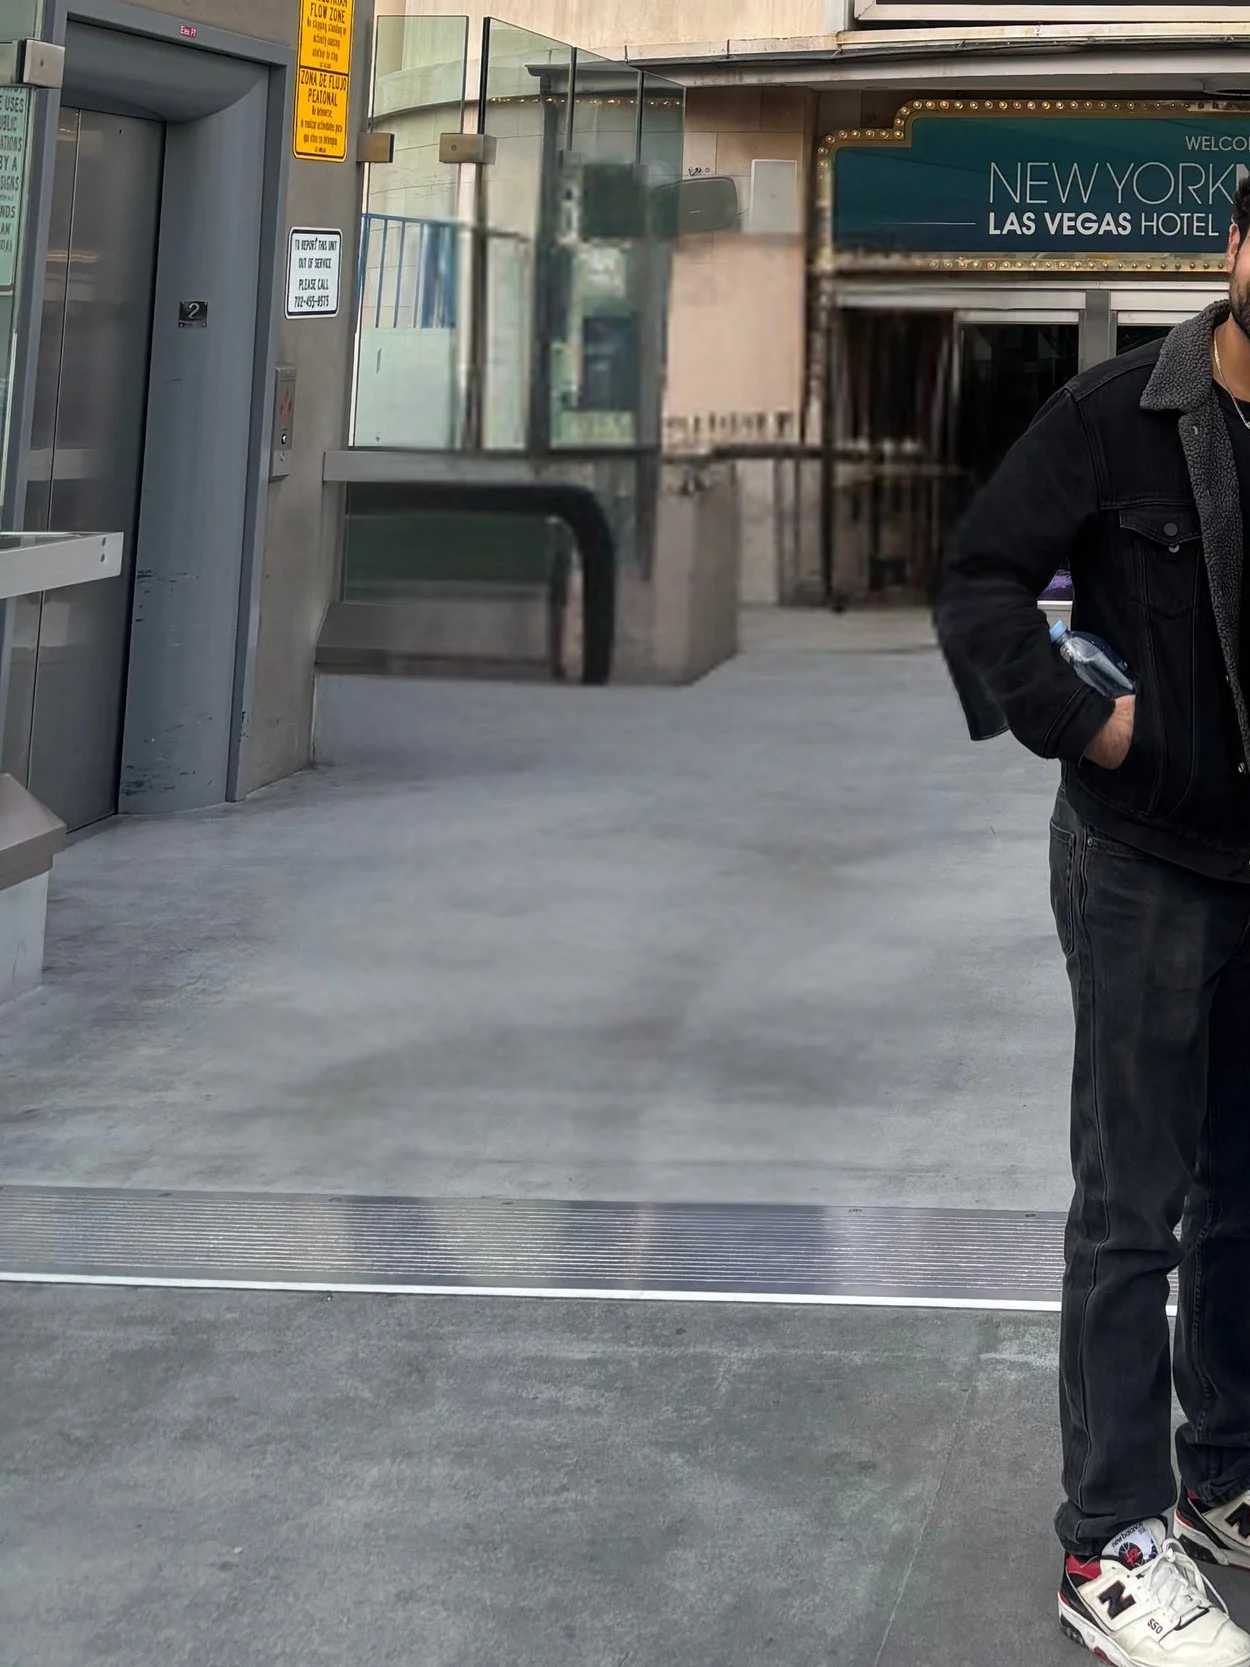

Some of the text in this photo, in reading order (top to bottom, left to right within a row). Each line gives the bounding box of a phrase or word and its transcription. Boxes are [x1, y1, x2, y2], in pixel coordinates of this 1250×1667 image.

[330, 7, 345, 24] ZONE
[300, 70, 317, 86] ZONA
[990, 163, 1098, 203] NEW
[989, 212, 1219, 235] LAS VEGAS HOTEL
[188, 302, 200, 319] 2
[1097, 1579, 1136, 1621] N
